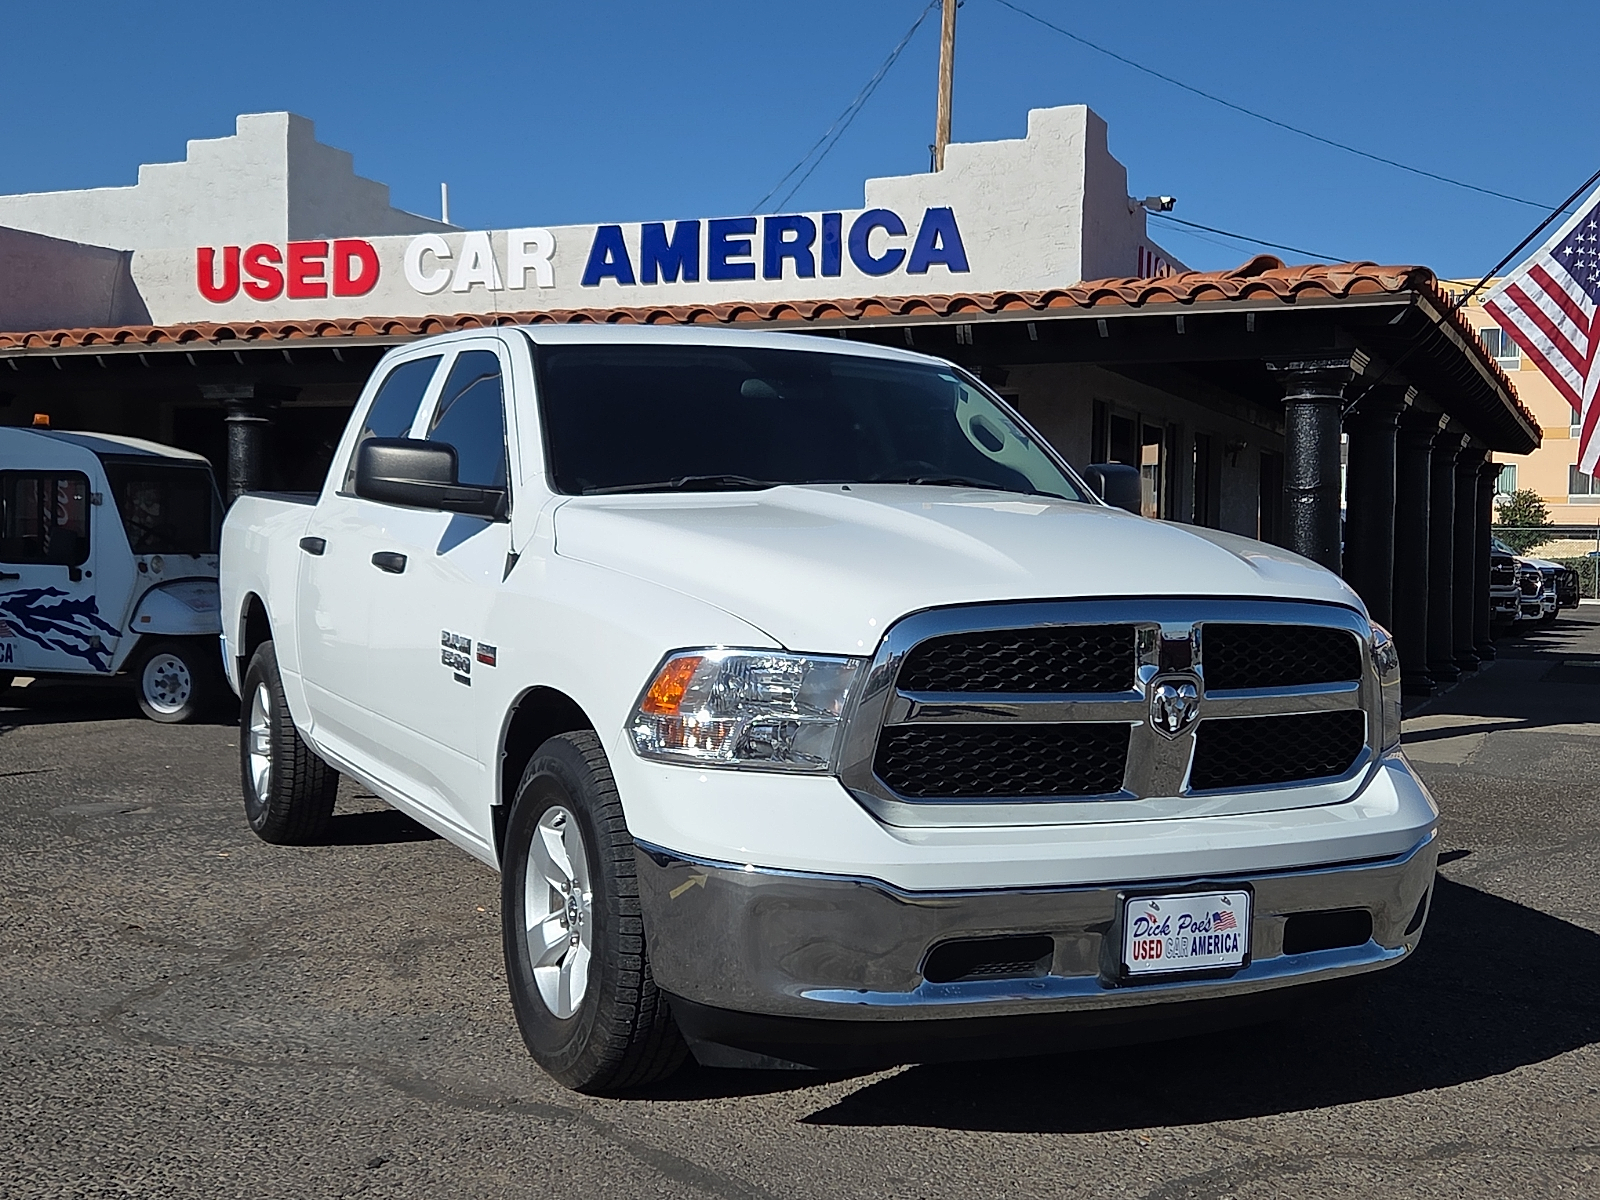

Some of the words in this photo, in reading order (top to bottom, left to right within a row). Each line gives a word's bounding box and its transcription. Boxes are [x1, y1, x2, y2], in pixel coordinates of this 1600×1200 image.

[196, 239, 380, 303] USED
[403, 227, 556, 296] CAR
[580, 206, 971, 288] AMERICA
[1133, 914, 1171, 938] Dick
[1177, 911, 1212, 936] Poe's
[1133, 938, 1163, 961] USED
[1165, 936, 1189, 959] CAR
[1190, 933, 1239, 957] AMERICA
